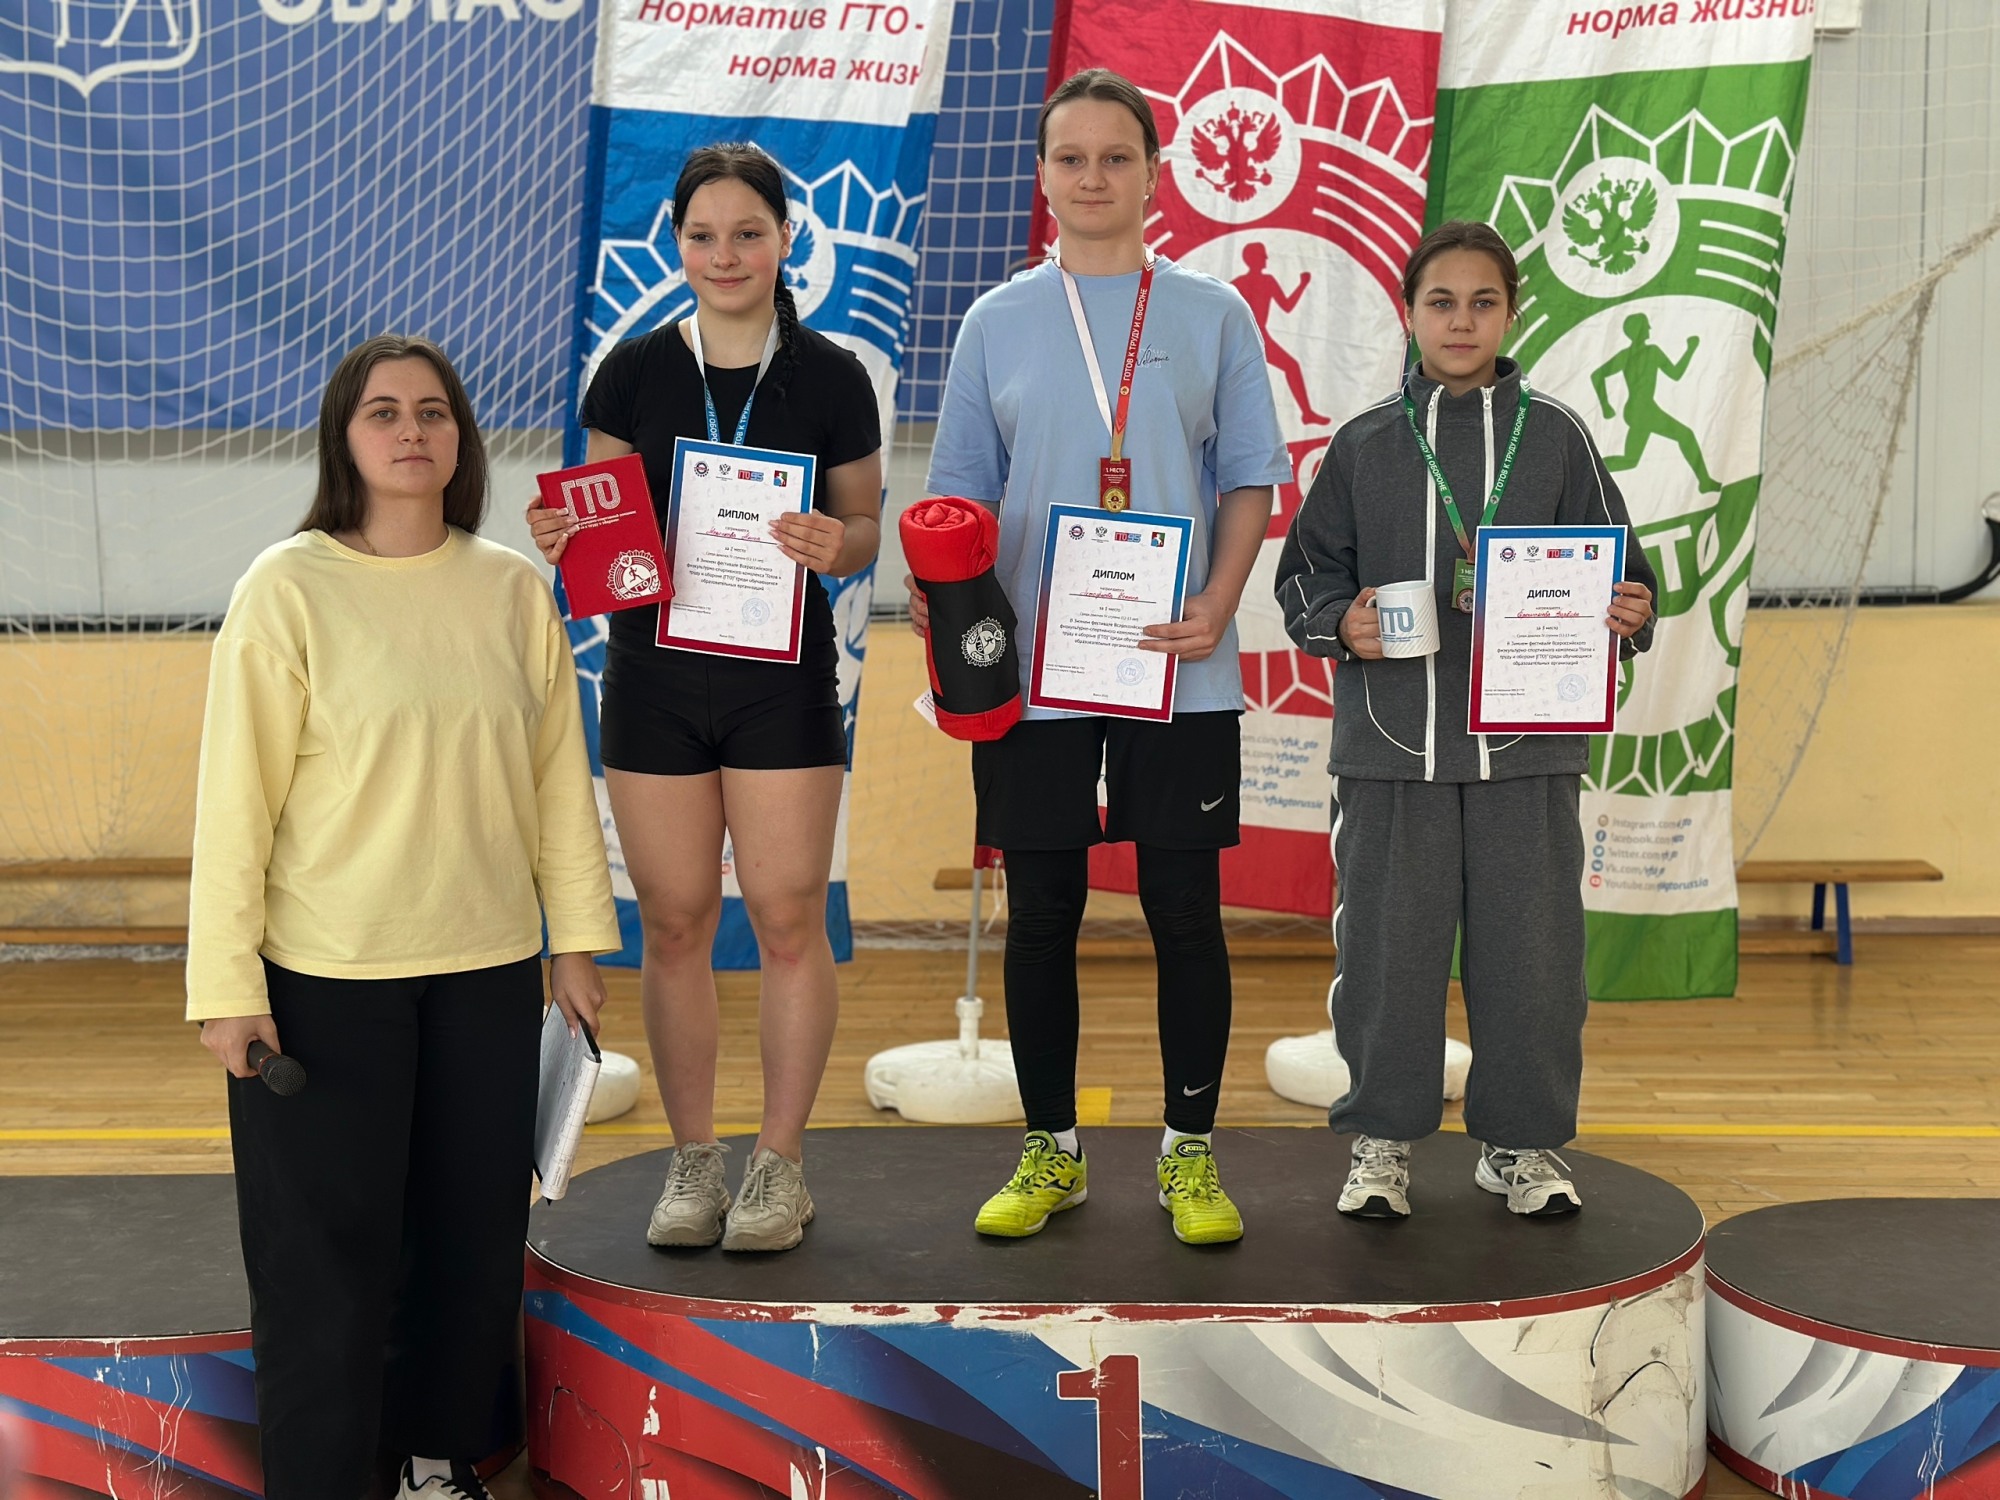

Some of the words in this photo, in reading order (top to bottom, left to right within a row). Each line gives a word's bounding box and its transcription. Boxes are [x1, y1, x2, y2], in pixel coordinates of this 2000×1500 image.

[638, 0, 827, 30] Норматив
[839, 3, 909, 35] ГТО
[1567, 1, 1679, 39] норма
[728, 54, 836, 83] норма
[846, 59, 921, 86] жизн
[1123, 358, 1134, 380] ГОТОВ
[1129, 328, 1140, 350] ТРУДУ
[1135, 288, 1148, 321] ОБОРОНЕ
[709, 418, 718, 441] ОБОРО
[734, 431, 743, 446] ТОВ
[1416, 435, 1430, 453] ТРУДУ
[1429, 461, 1447, 492] ОБОРОНЕ
[1496, 470, 1508, 491] ГОТОВ
[1505, 444, 1517, 463] ТРУДУ
[1513, 407, 1526, 435] ОБОРОНЕ
[561, 473, 620, 520] ГТО
[718, 508, 760, 522] ДИПЛОМ
[635, 580, 649, 592] ГТО
[1092, 569, 1135, 581] ДИПЛОМ
[1527, 589, 1570, 599] ДИПЛОМ
[1379, 607, 1414, 633] ГТО
[1026, 1140, 1041, 1148] oma
[1057, 1353, 1143, 1500] 1
